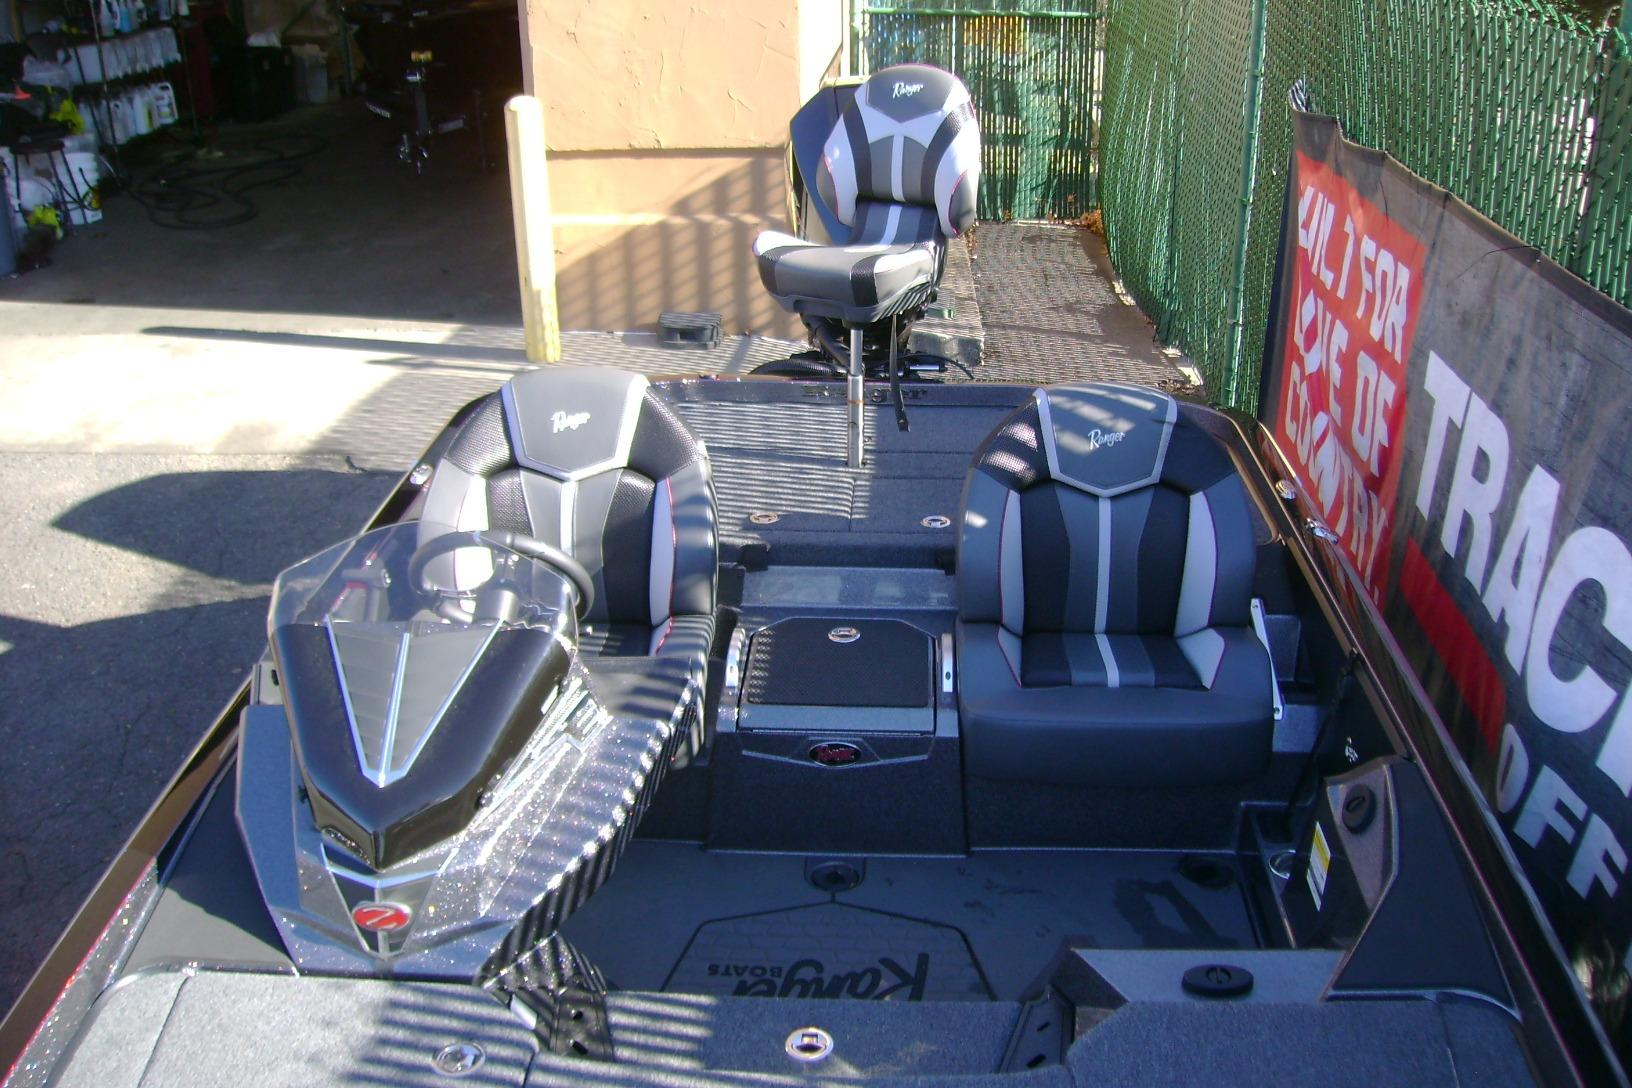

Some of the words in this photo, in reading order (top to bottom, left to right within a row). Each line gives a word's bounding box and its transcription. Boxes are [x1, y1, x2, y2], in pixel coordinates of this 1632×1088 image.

[1356, 234, 1410, 364] FOR
[1088, 429, 1125, 450] Ranger
[1352, 350, 1396, 477] OF
[1496, 723, 1628, 899] OFF
[708, 964, 783, 979] BOATS
